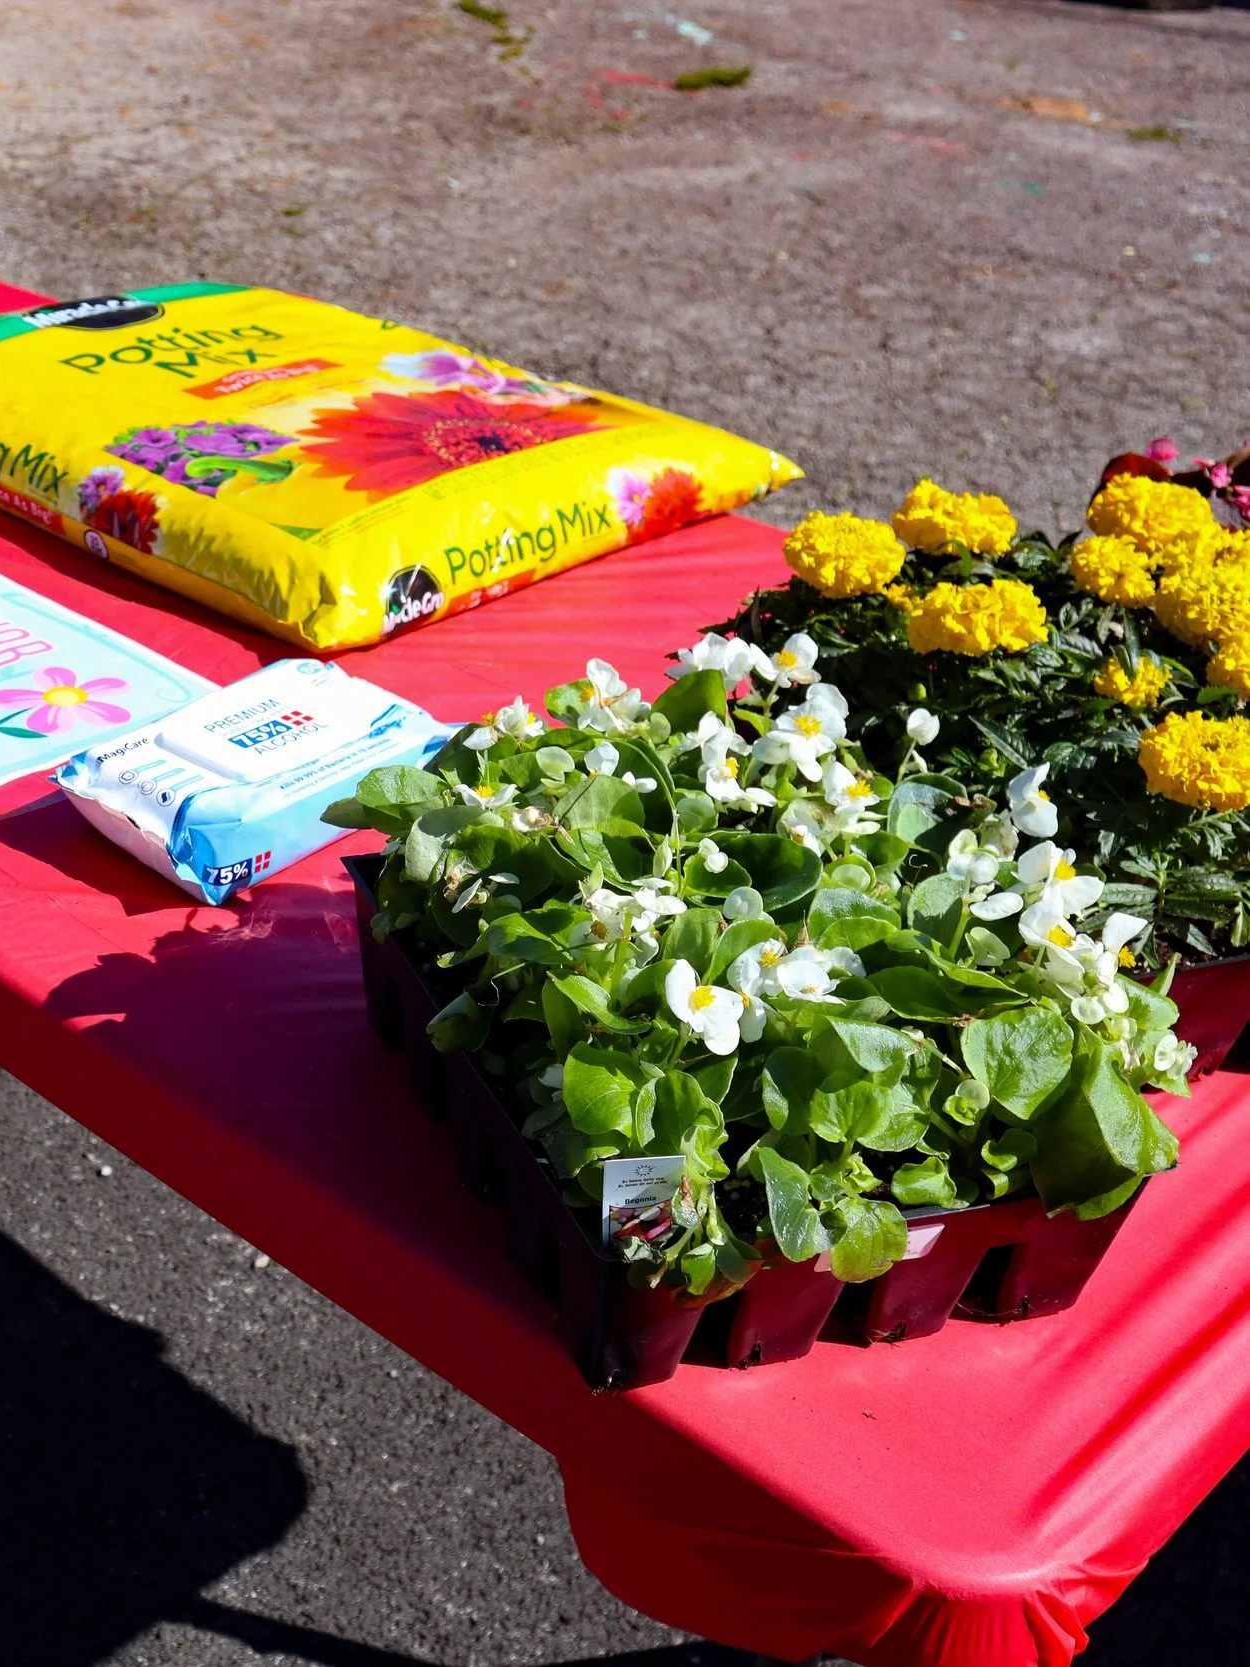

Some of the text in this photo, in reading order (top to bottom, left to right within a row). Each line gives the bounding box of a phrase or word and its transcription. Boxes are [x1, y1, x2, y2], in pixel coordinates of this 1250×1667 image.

[57, 325, 285, 374] Potting
[153, 349, 280, 379] Mix
[9, 444, 69, 499] Mix
[444, 501, 612, 585] Potting Mix
[203, 698, 281, 733] PREMIUM
[231, 722, 288, 747] 75%
[254, 722, 329, 755] ALCOHOL
[206, 861, 249, 885] 75%
[624, 1196, 657, 1205] Begonia
